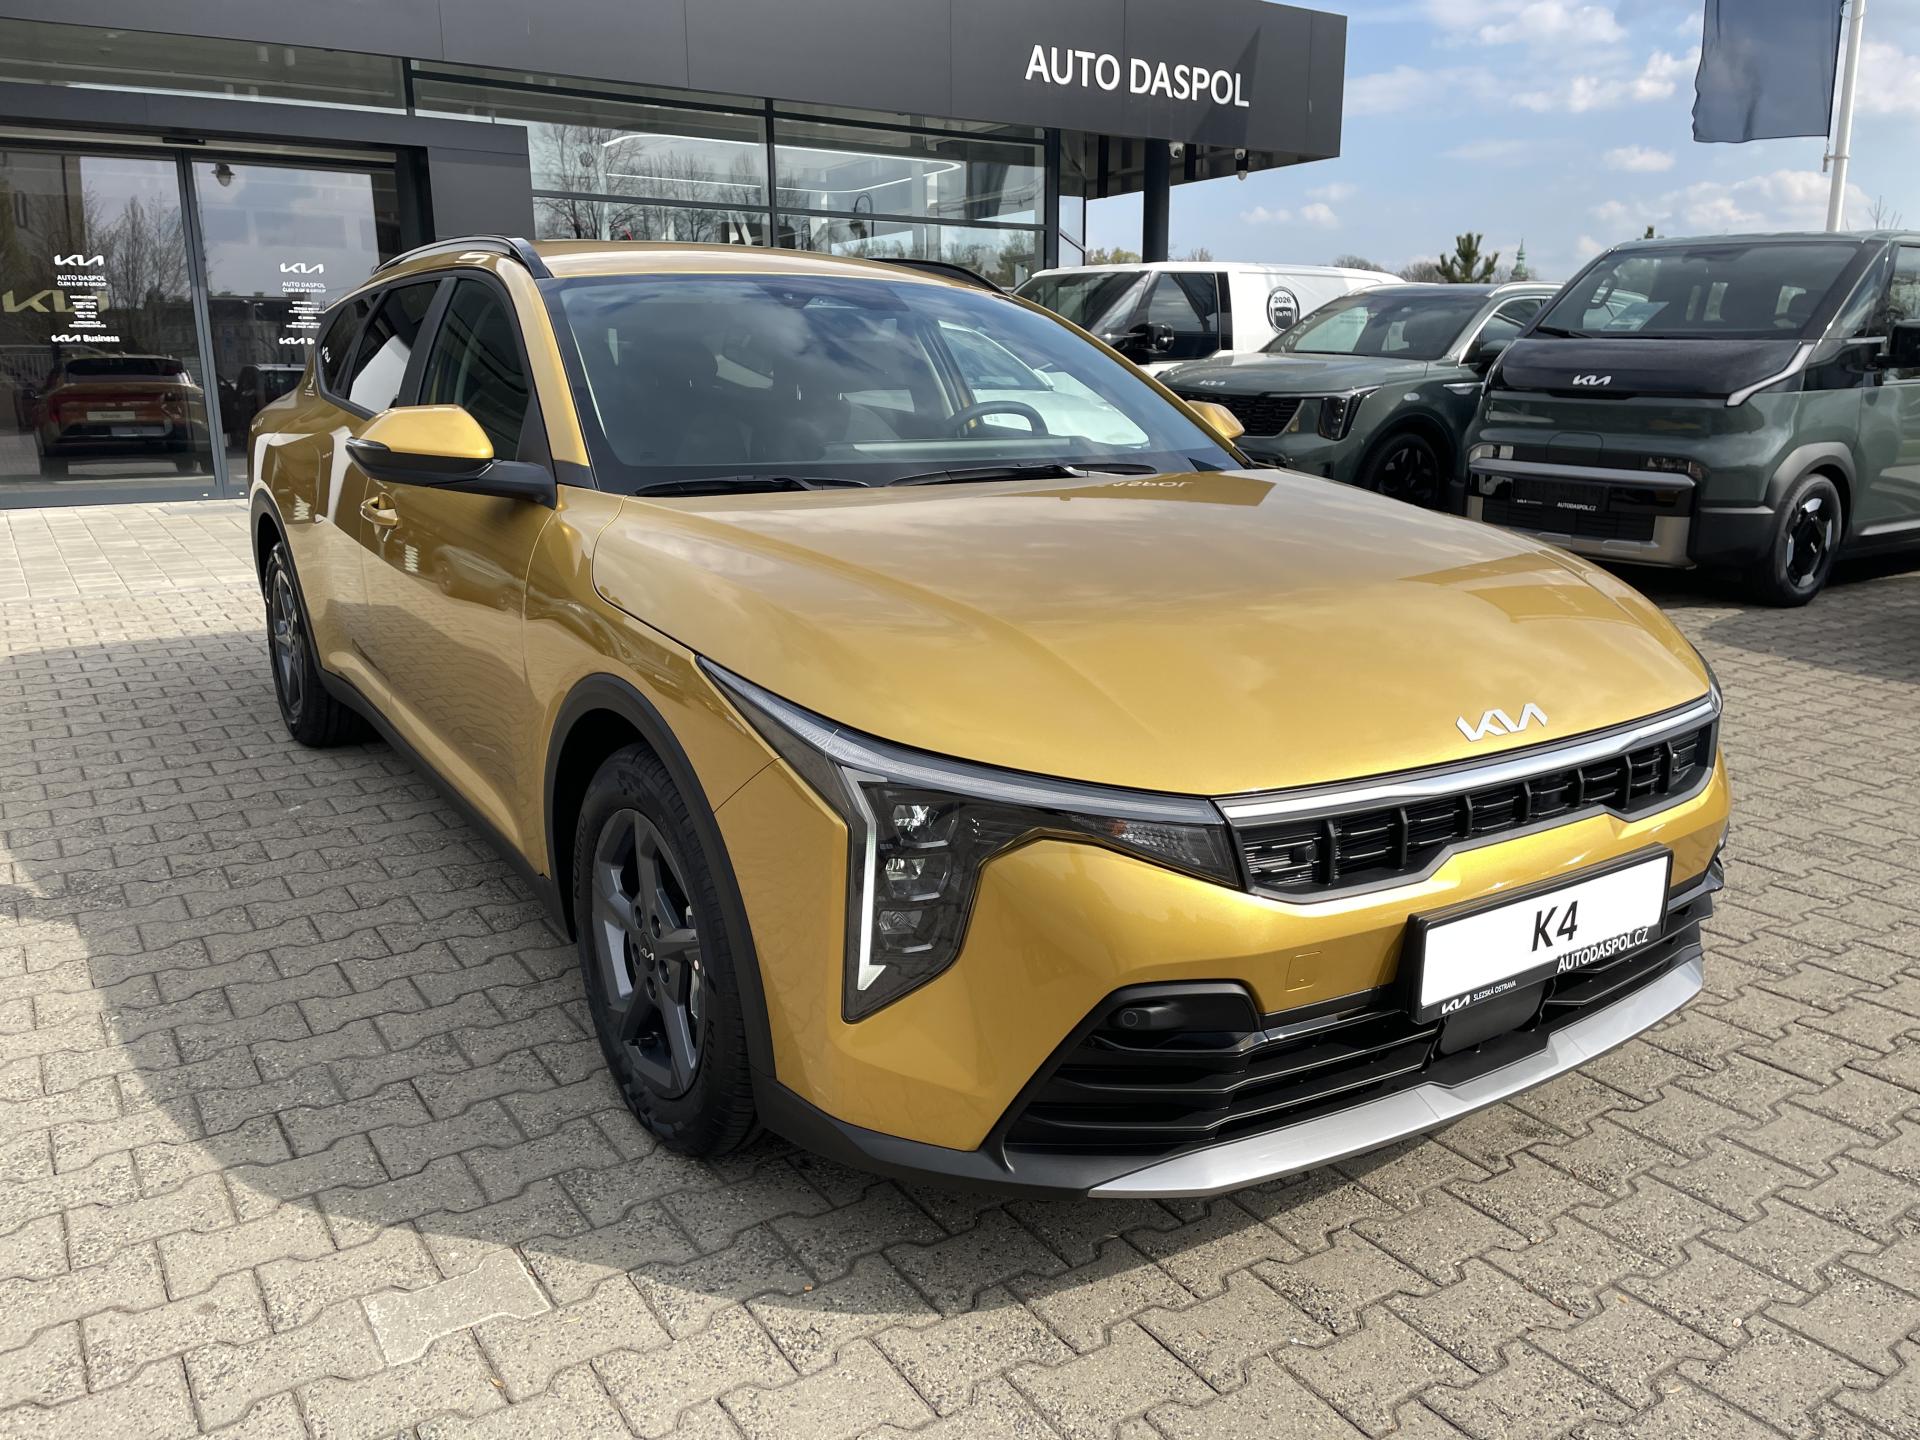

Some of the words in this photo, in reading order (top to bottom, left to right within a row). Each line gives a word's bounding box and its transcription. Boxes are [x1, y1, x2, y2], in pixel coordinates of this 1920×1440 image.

[1024, 44, 1121, 91] AUTO
[1129, 58, 1250, 108] DASPOL
[54, 254, 104, 266] KIA
[280, 263, 324, 274] KIA
[83, 334, 120, 342] Business
[1573, 375, 1611, 385] KIA
[1456, 702, 1548, 742] KIA
[1532, 901, 1578, 952] K4
[1556, 927, 1649, 973] AUTODASPOL.CZ
[1441, 994, 1471, 1014] KIA
[1472, 986, 1495, 1001] SLEZSKÁ
[1495, 980, 1517, 993] OSTRAVA
